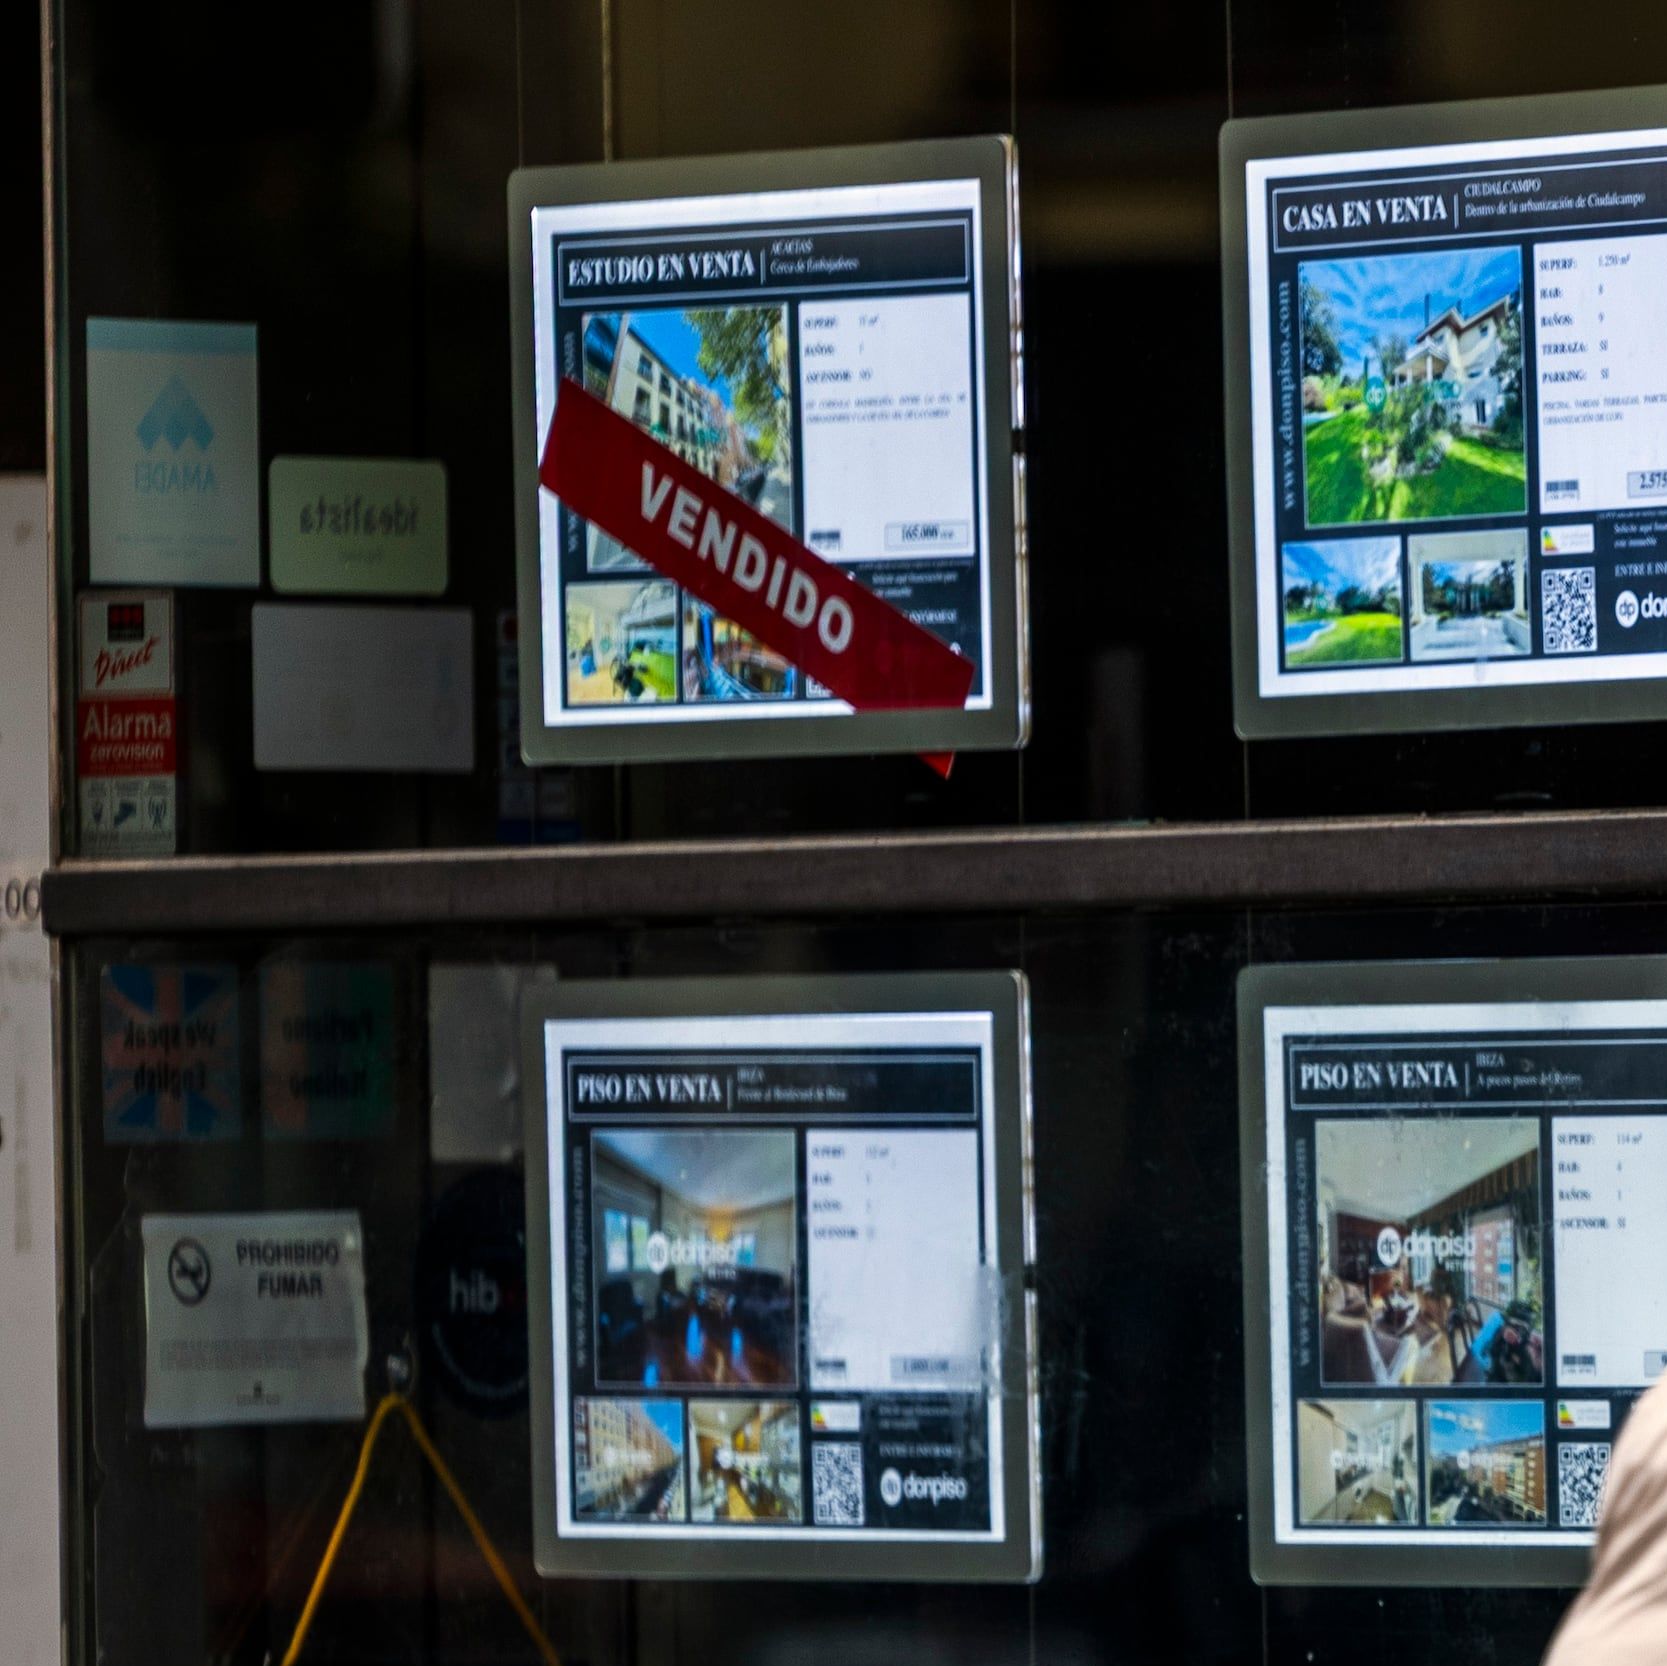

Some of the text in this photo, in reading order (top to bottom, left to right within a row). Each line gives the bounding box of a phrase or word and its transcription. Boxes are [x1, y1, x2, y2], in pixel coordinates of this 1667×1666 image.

[1282, 194, 1448, 233] CASA EN VENTA
[568, 249, 755, 286] ESTUDIO EN VENTA
[641, 460, 855, 655] VENDIDO
[83, 703, 173, 742] Alarma
[89, 742, 165, 763] zerovision
[578, 1074, 722, 1102] PISO EN VENTA
[1300, 1061, 1458, 1090] PISO EN VENTA
[236, 1239, 339, 1266] PROHIBIDO
[257, 1275, 323, 1298] FUMAR
